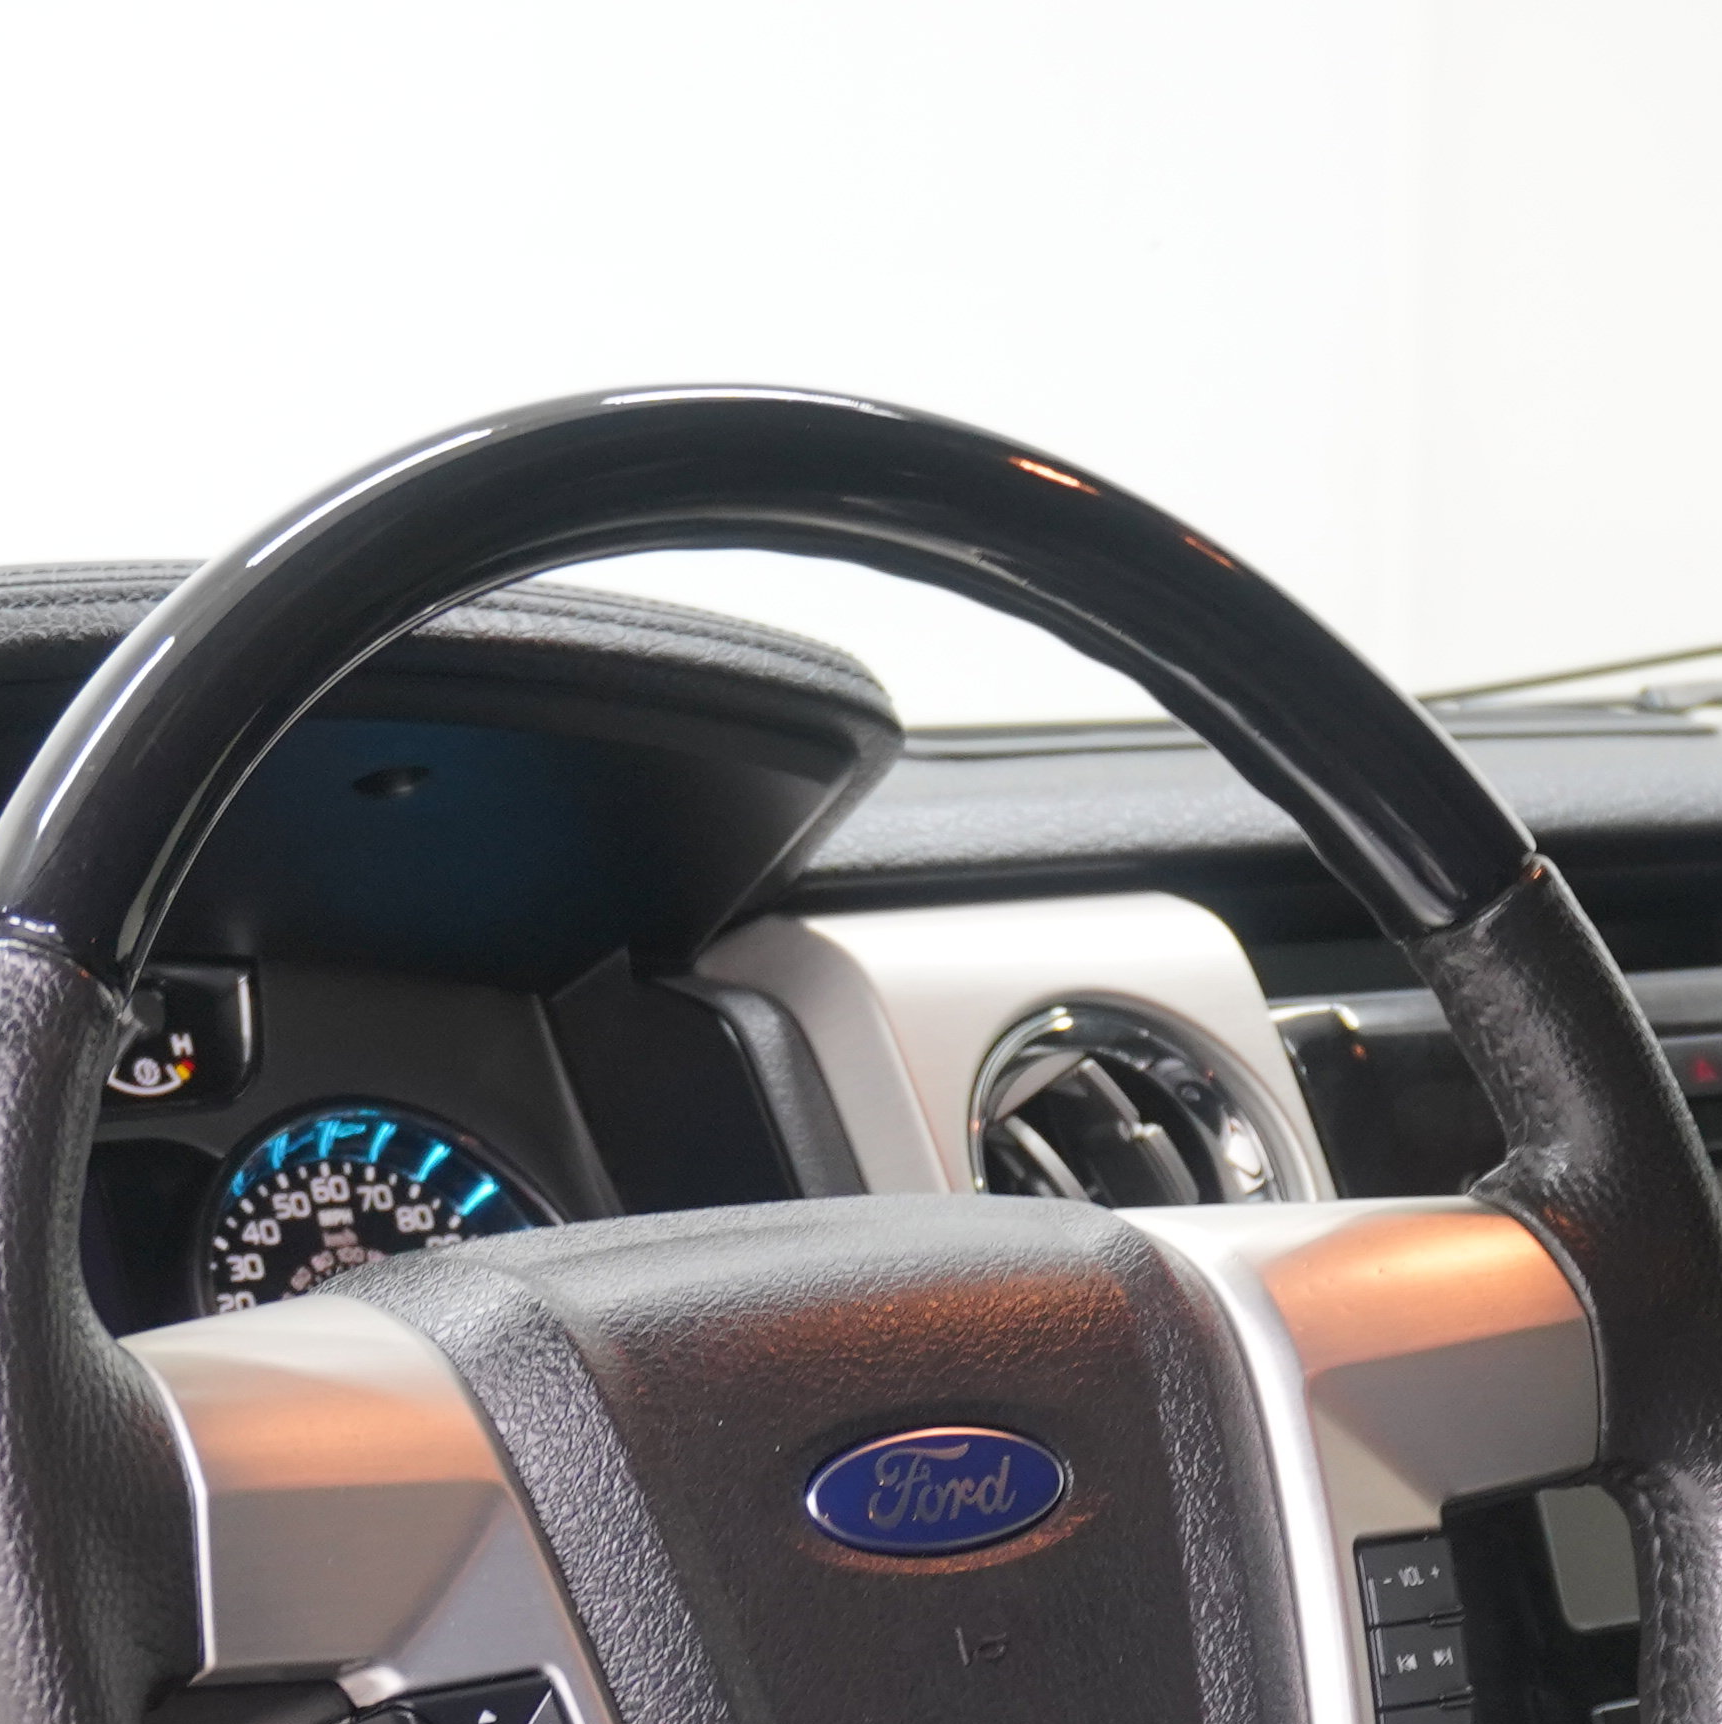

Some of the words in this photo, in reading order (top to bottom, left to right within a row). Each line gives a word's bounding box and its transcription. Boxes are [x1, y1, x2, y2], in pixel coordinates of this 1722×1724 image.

[169, 1032, 194, 1057] H
[310, 1176, 350, 1203] 60
[356, 1184, 393, 1212] 70
[272, 1191, 312, 1220] 50
[395, 1205, 435, 1233] 80
[242, 1218, 281, 1246] 40
[226, 1253, 265, 1282] 30
[867, 1441, 1017, 1531] Ford
[1398, 1565, 1425, 1587] VOL
